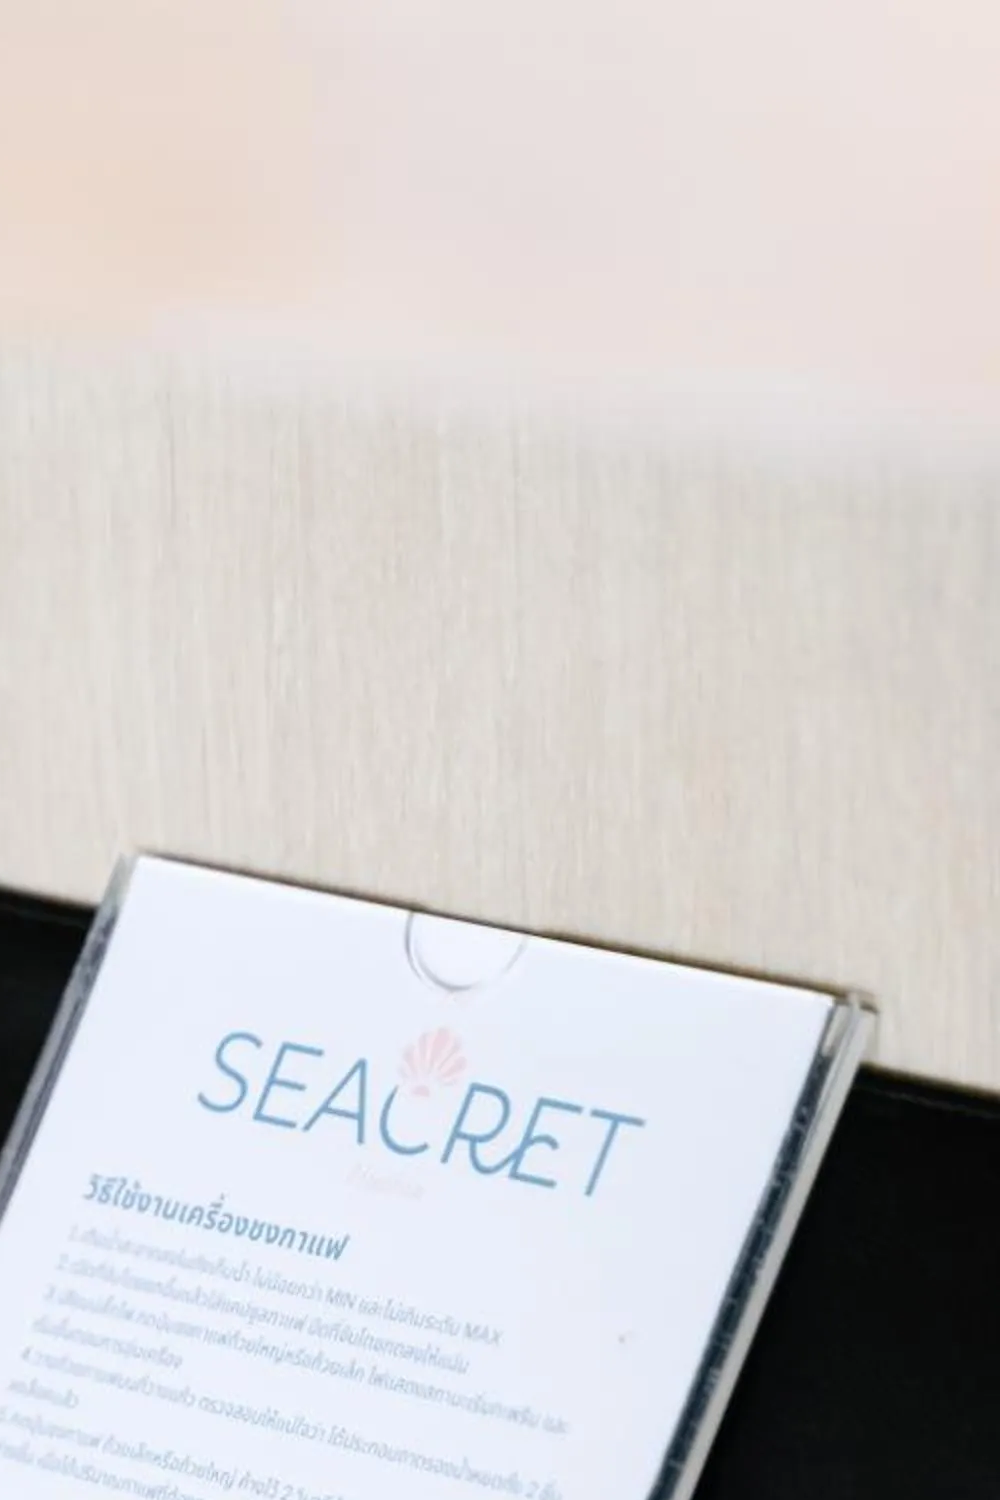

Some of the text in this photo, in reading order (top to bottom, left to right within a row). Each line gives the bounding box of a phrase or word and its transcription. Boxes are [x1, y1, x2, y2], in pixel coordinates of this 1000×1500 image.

[197, 1031, 646, 1197] SEACRET
[83, 1174, 351, 1262] วิธีใช้งานเครื่องชงกาแฟ
[464, 1322, 504, 1347] MAX
